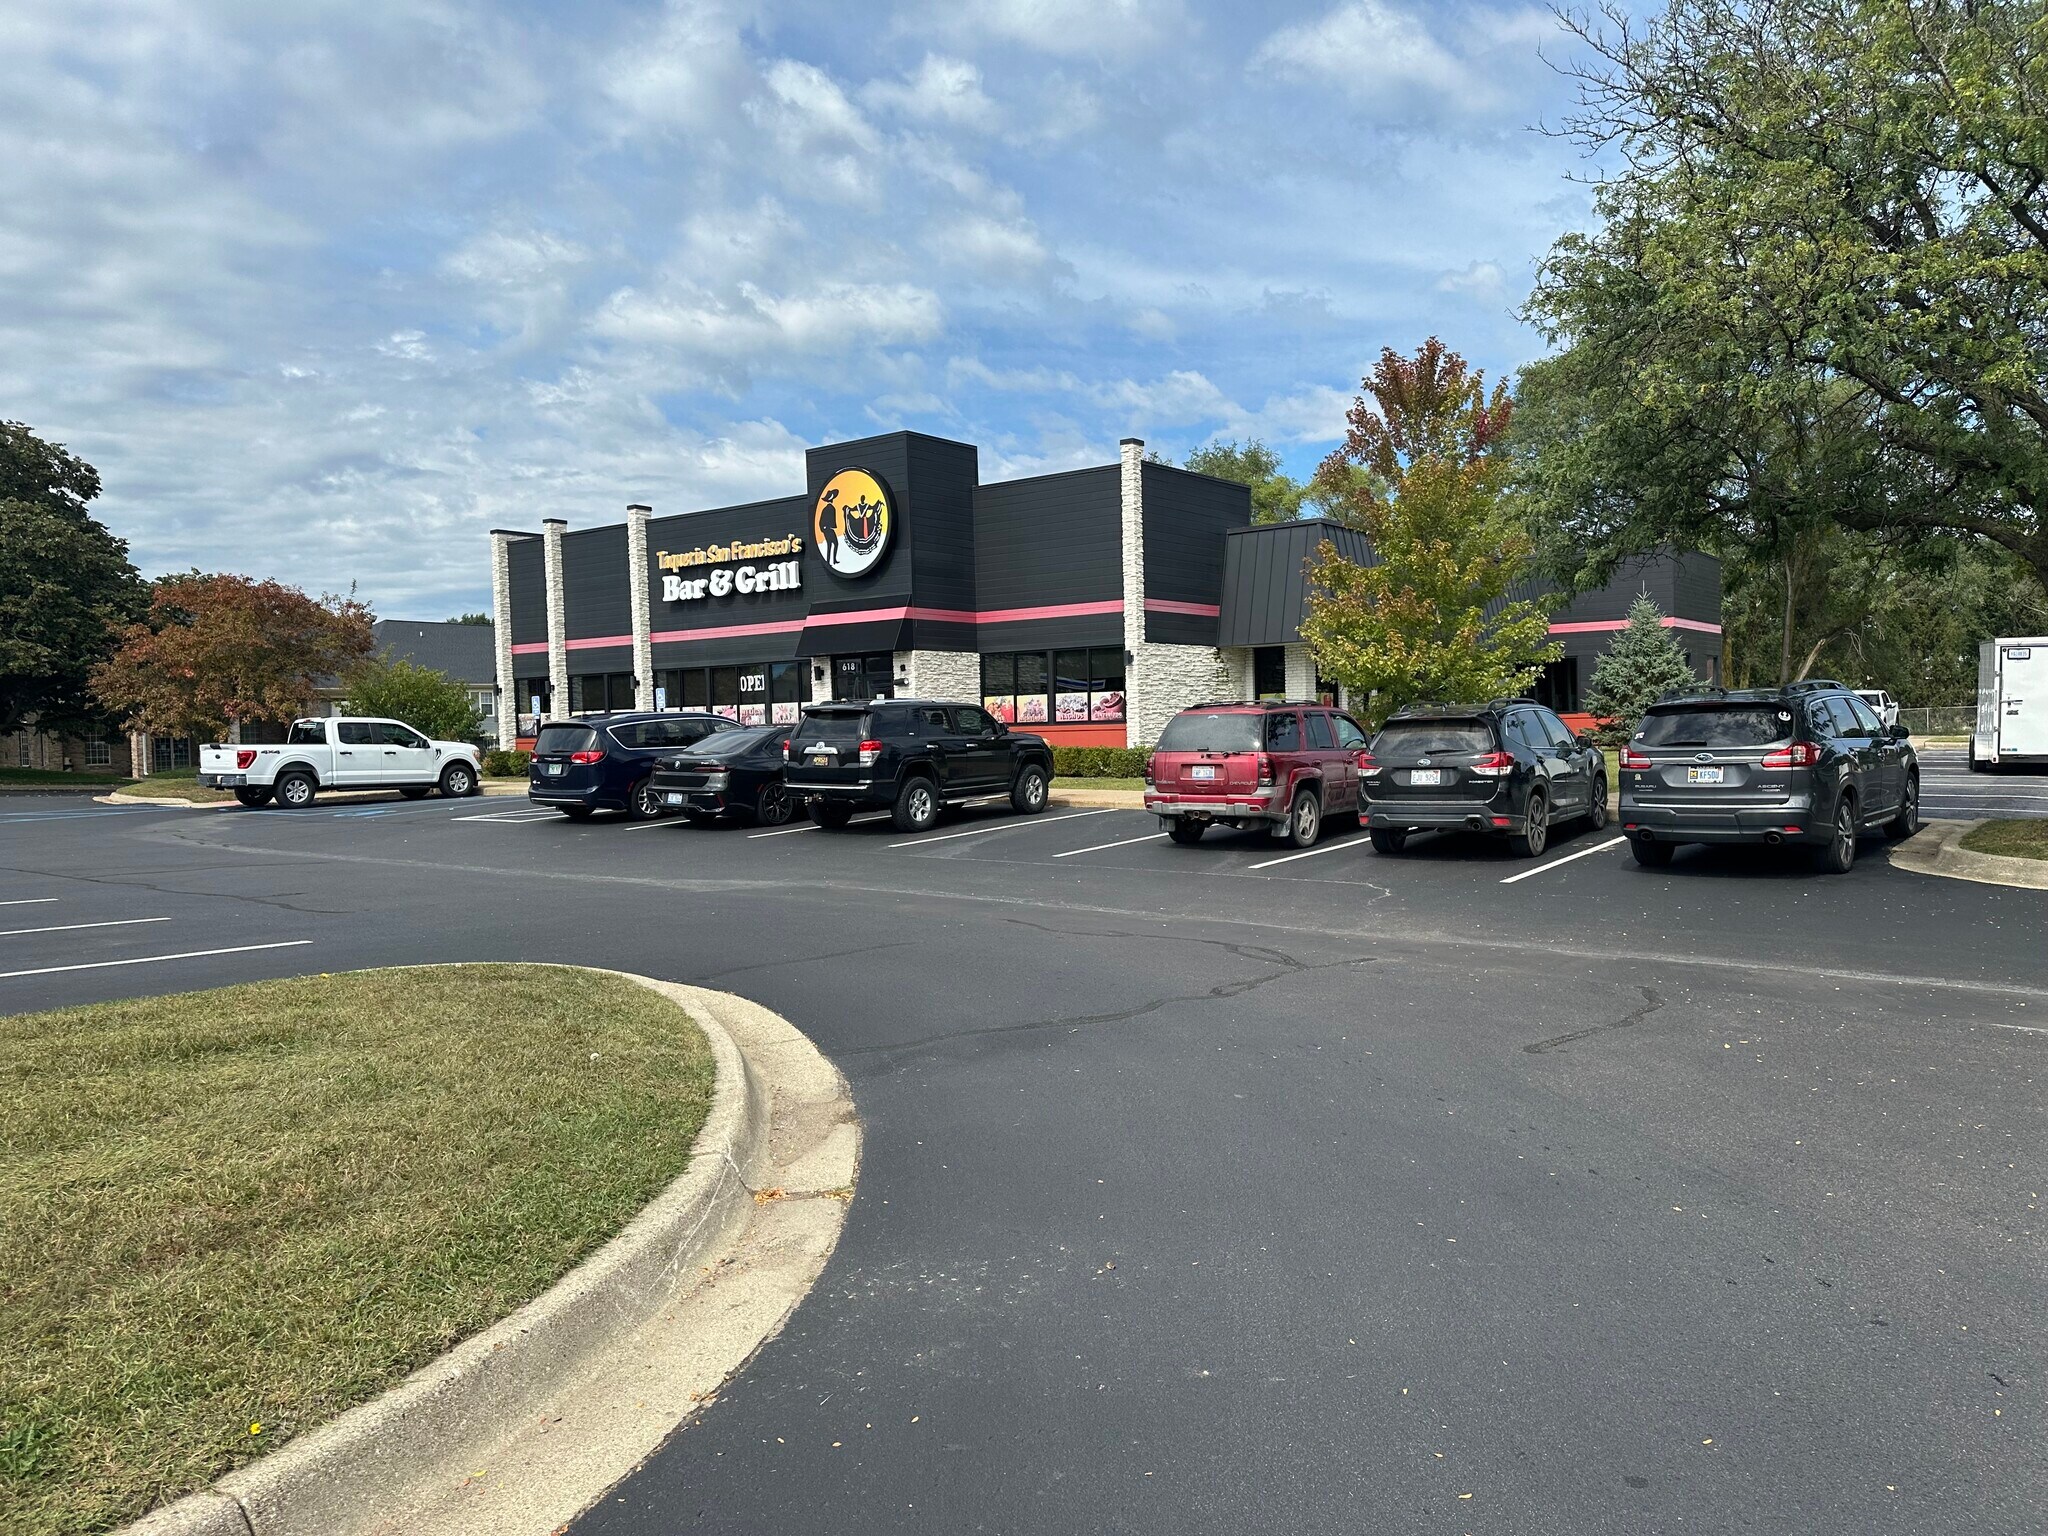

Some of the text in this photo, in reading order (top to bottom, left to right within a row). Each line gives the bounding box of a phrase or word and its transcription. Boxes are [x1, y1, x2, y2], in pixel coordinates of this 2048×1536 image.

[656, 534, 802, 572] Taqueria San Francisco's
[662, 562, 801, 602] Bar & Grill
[842, 663, 856, 671] 618
